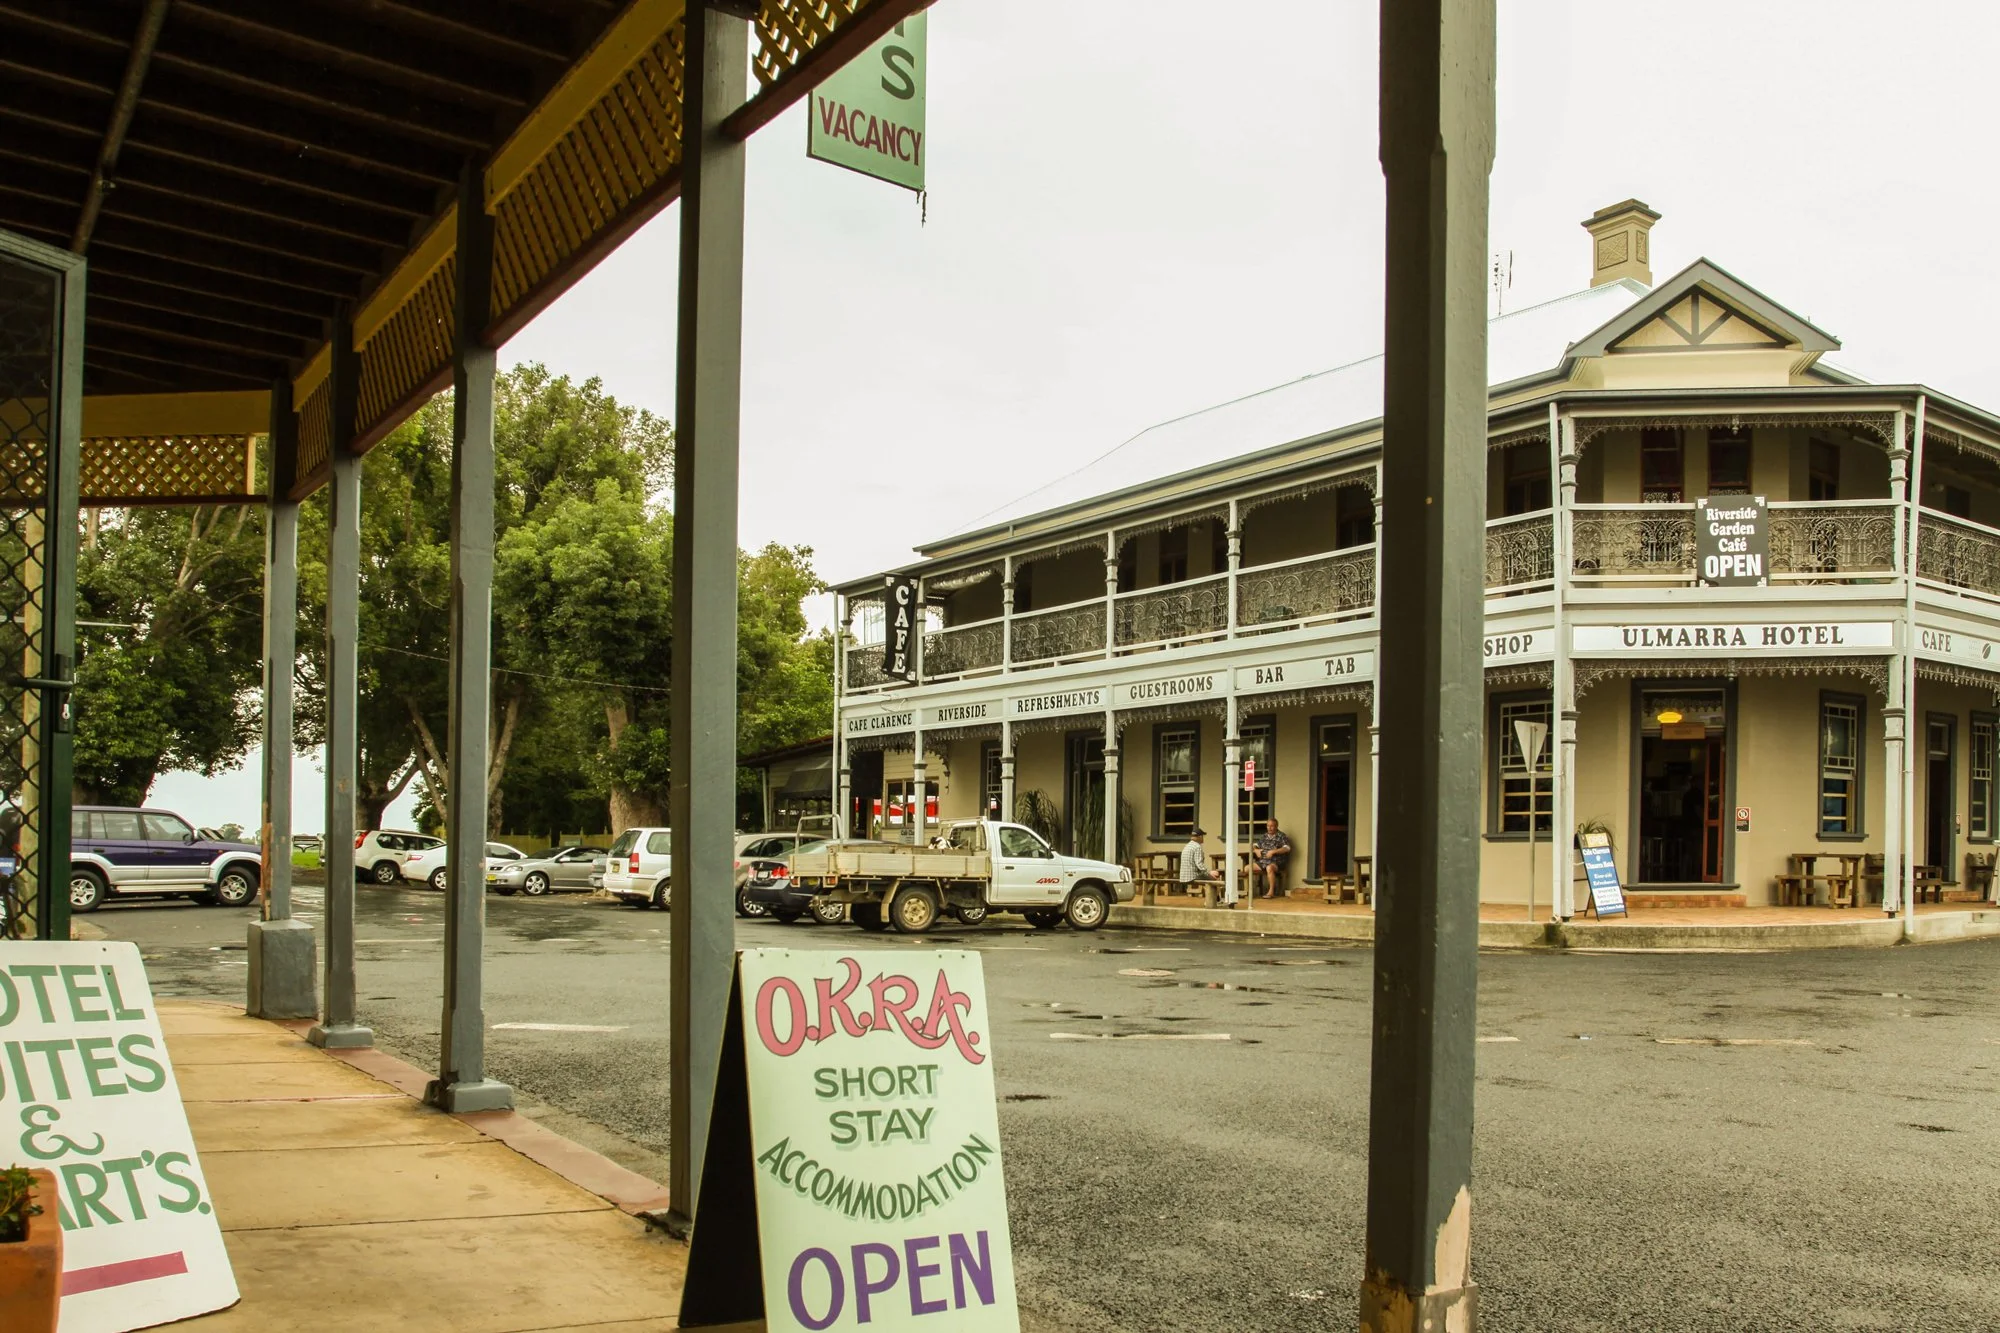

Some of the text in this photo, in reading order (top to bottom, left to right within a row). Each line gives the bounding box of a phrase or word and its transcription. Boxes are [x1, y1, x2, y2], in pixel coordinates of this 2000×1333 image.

[818, 96, 922, 166] VACANCY
[1706, 507, 1757, 521] Riverside
[1709, 521, 1755, 536] Garden
[1718, 537, 1747, 552] Café
[1705, 554, 1762, 578] OPEN
[892, 585, 909, 673] CAFE
[1622, 625, 1844, 648] ULMARRA HOTEL
[1484, 634, 1533, 657] SHOP
[1922, 630, 1952, 653] CAFE
[1255, 657, 1355, 685] BAR TAB
[1130, 675, 1213, 700] GUESTROOMS
[938, 703, 987, 722] RIVERSIDE
[1017, 690, 1100, 714] REFRESHMENTS
[849, 713, 913, 731] CAFE CLARENCE
[0, 1034, 166, 1103] ITES
[813, 1064, 939, 1098] SHORT
[20, 1104, 105, 1160] &
[829, 1107, 934, 1144] STAY
[757, 1134, 996, 1221] ACCOMMODATION
[788, 1230, 996, 1331] OPEN
